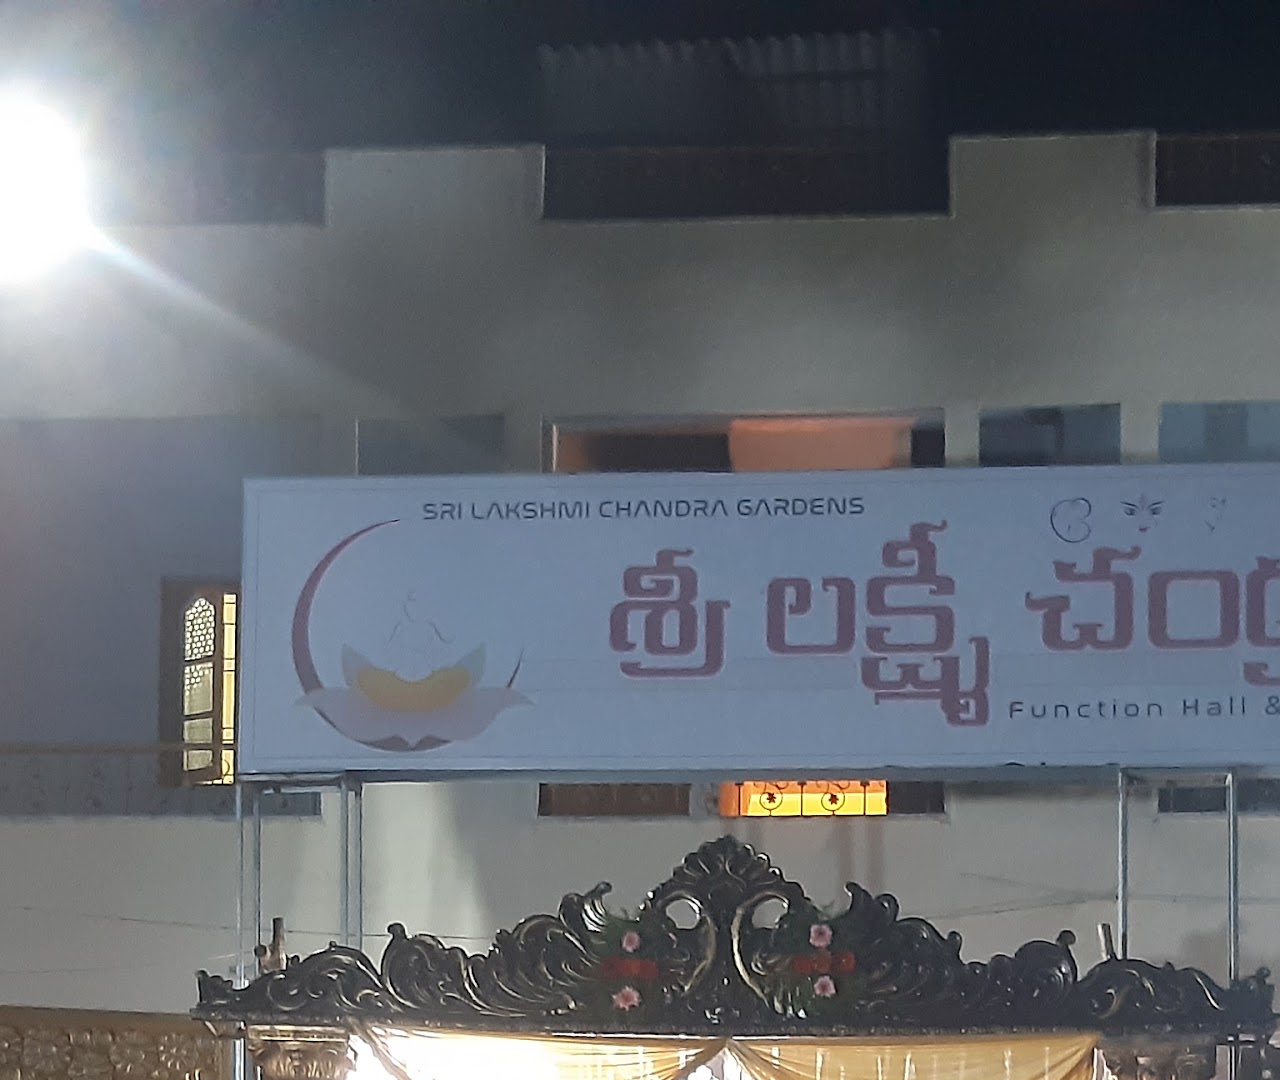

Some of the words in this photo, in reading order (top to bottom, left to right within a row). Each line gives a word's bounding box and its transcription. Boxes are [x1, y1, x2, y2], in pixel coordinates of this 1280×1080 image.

[422, 502, 462, 520] SRI
[471, 501, 590, 520] LAKSHMI
[598, 499, 729, 519] CHANDRA
[736, 497, 866, 517] GARDENS
[609, 548, 731, 678] శ్రీ
[766, 520, 990, 727] లక్ష్మీ
[1008, 698, 1164, 719] Function
[1182, 695, 1246, 717] Hall
